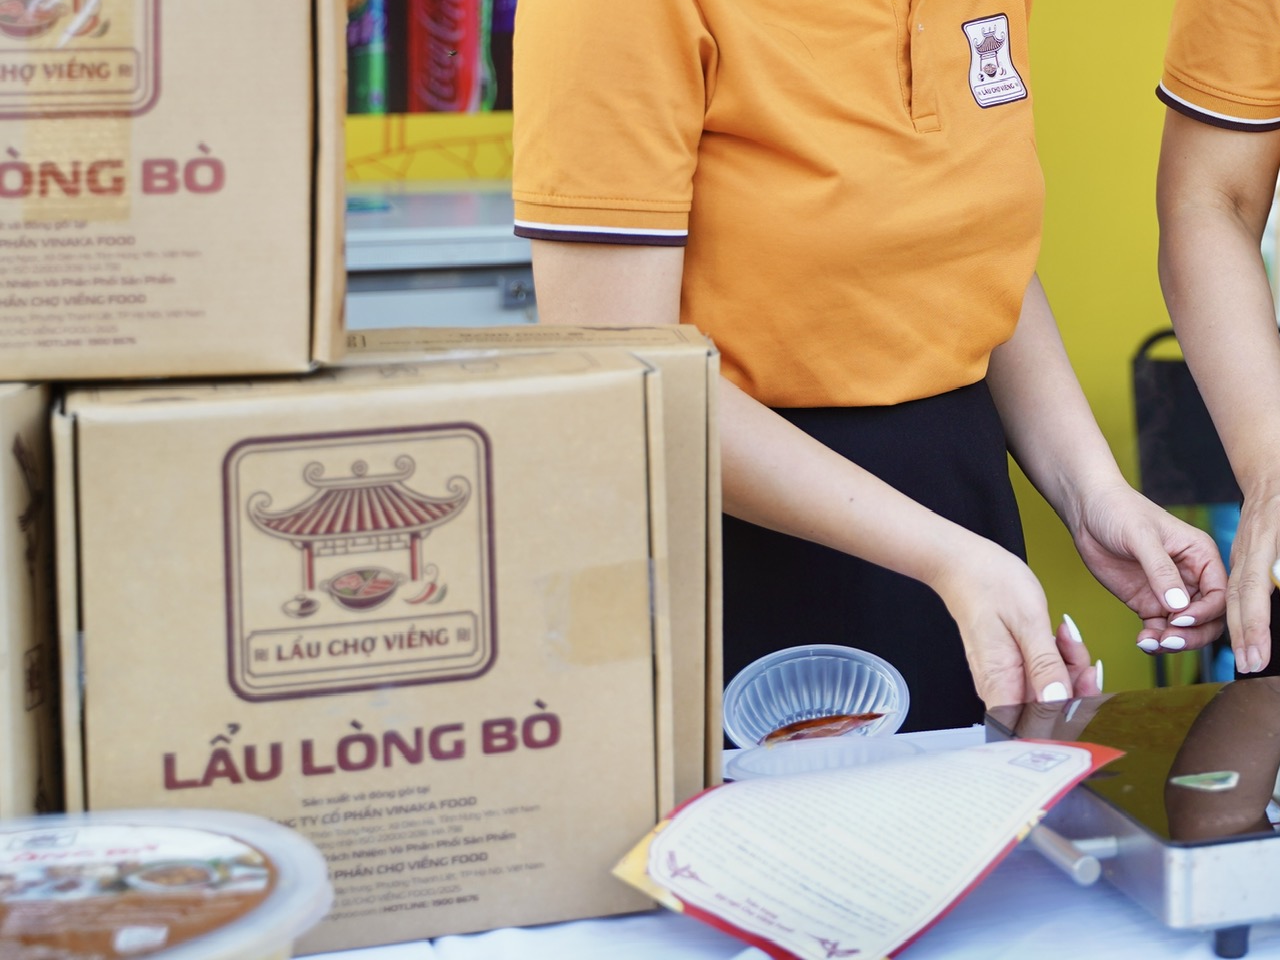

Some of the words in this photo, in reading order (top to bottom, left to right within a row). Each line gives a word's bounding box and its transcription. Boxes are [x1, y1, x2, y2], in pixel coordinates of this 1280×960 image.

[0, 63, 36, 86] HỢ
[0, 146, 126, 199] ÒNG
[140, 140, 226, 195] BÒ
[97, 235, 136, 246] FOOD
[107, 294, 147, 306] FOOD
[274, 634, 321, 662] LẨU
[327, 636, 378, 658] CHỢ
[162, 722, 283, 790] LẨU
[300, 720, 466, 777] LÒNG
[481, 699, 562, 756] BÒ
[301, 814, 318, 828] TY
[386, 800, 437, 817] VINAKA
[440, 796, 478, 810] FOOD
[451, 851, 488, 865] FOOD
